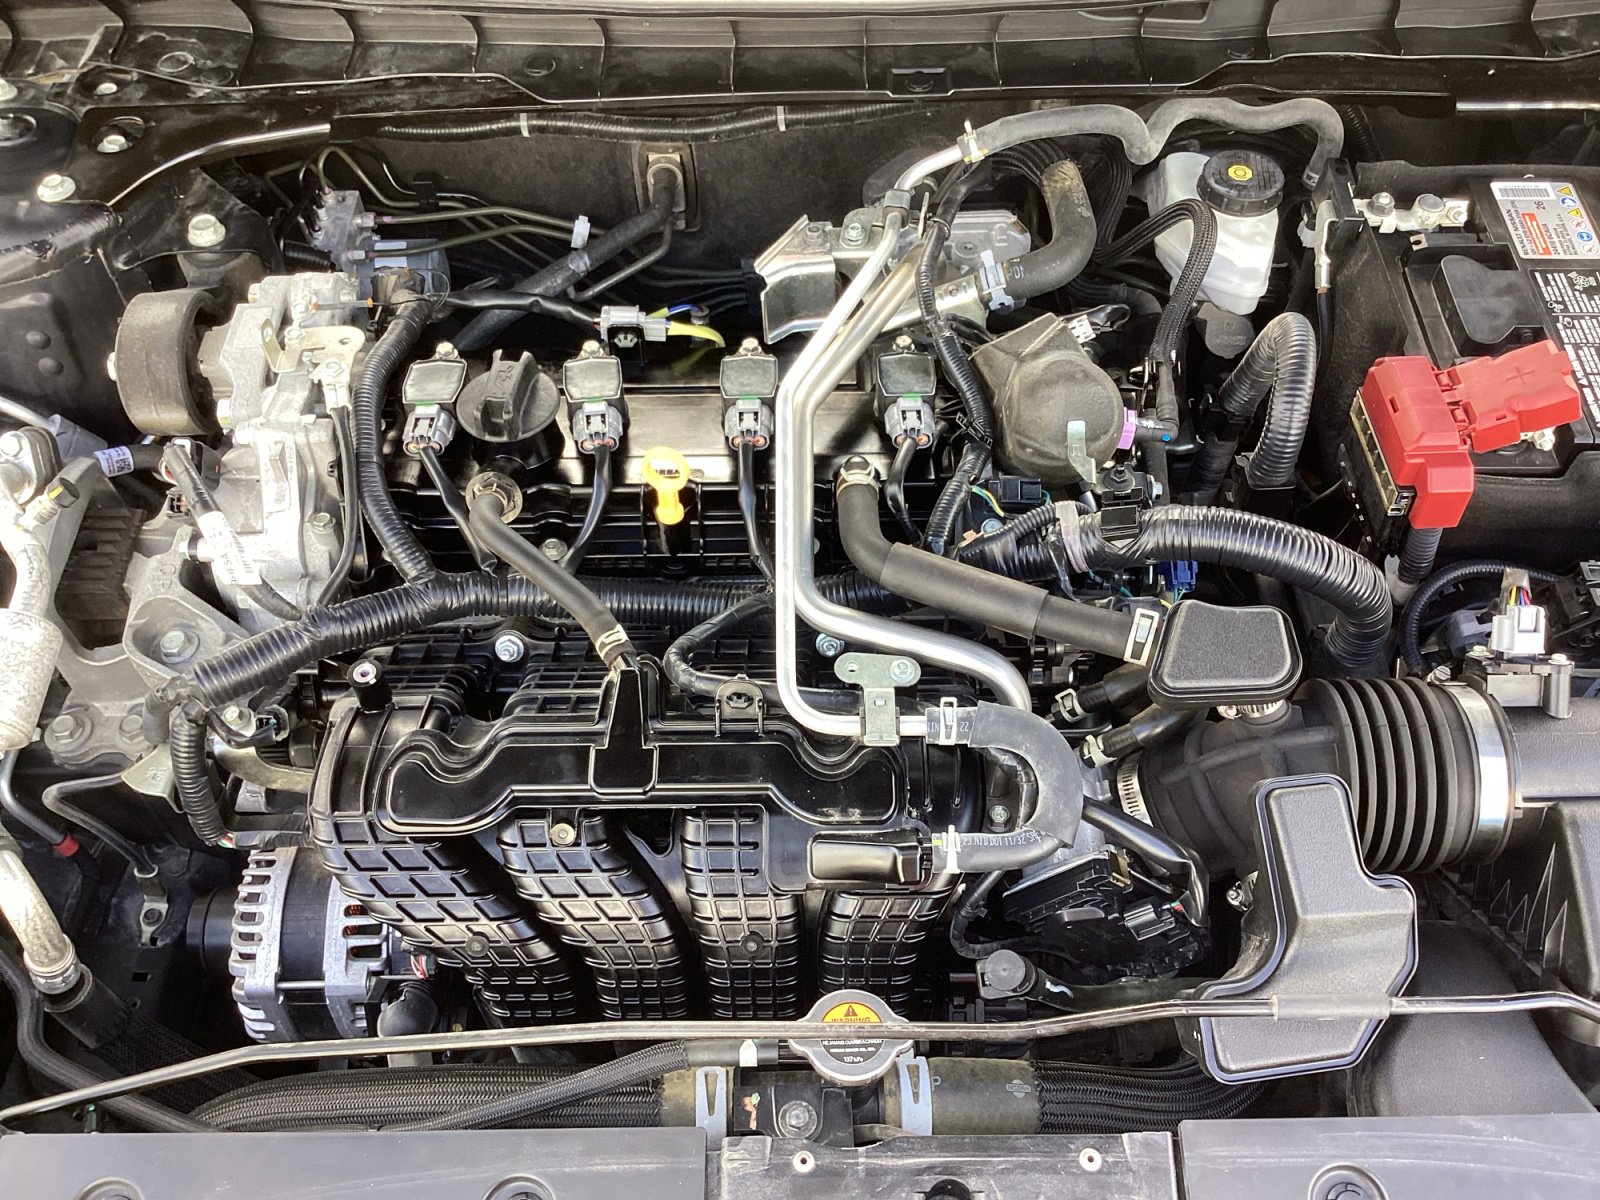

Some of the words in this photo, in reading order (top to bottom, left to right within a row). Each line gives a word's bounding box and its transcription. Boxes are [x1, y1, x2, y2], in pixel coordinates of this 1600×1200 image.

[1534, 201, 1546, 211] 26
[1507, 209, 1519, 231] NISSAN
[959, 721, 970, 732] 22
